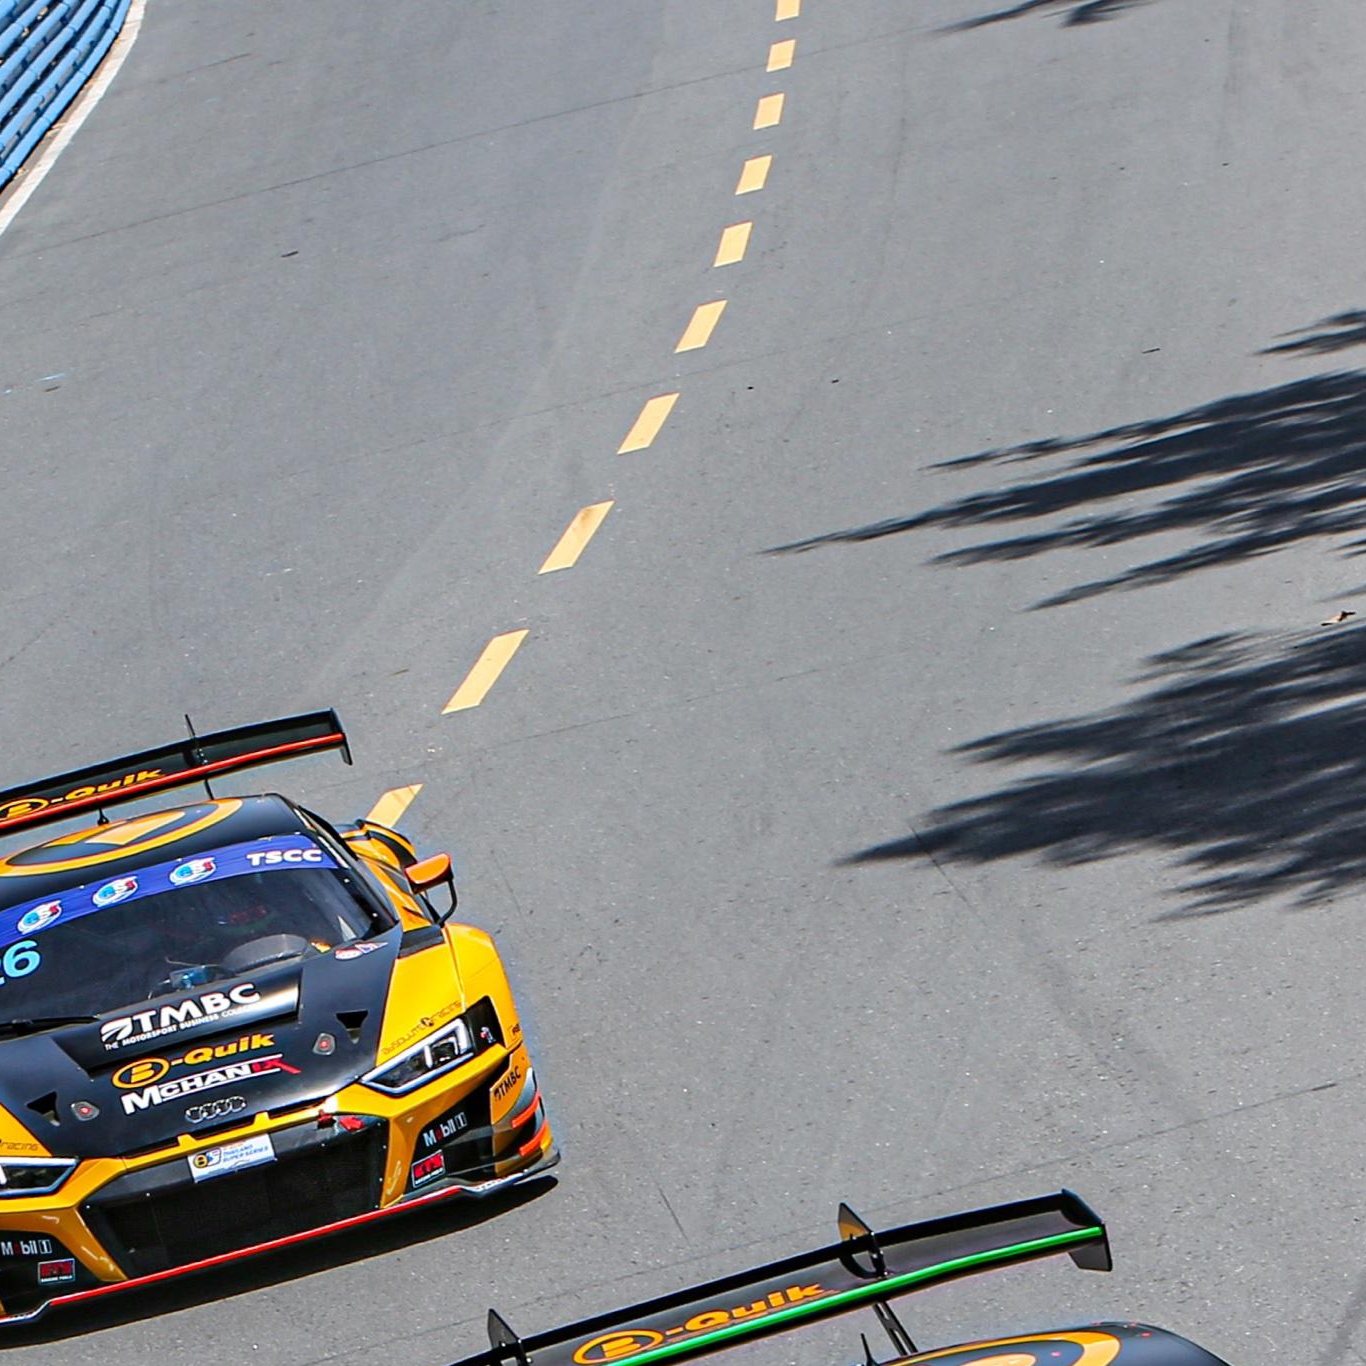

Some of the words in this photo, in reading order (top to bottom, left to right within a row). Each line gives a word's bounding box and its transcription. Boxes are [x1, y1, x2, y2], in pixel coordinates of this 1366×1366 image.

[246, 849, 323, 867] TSCC
[122, 1023, 178, 1045] MOTORSPORT
[180, 1013, 220, 1031] BUSINESS
[132, 983, 262, 1034] TMBC
[111, 1033, 275, 1089] B-Quik
[573, 1283, 825, 1364] B-Quik
